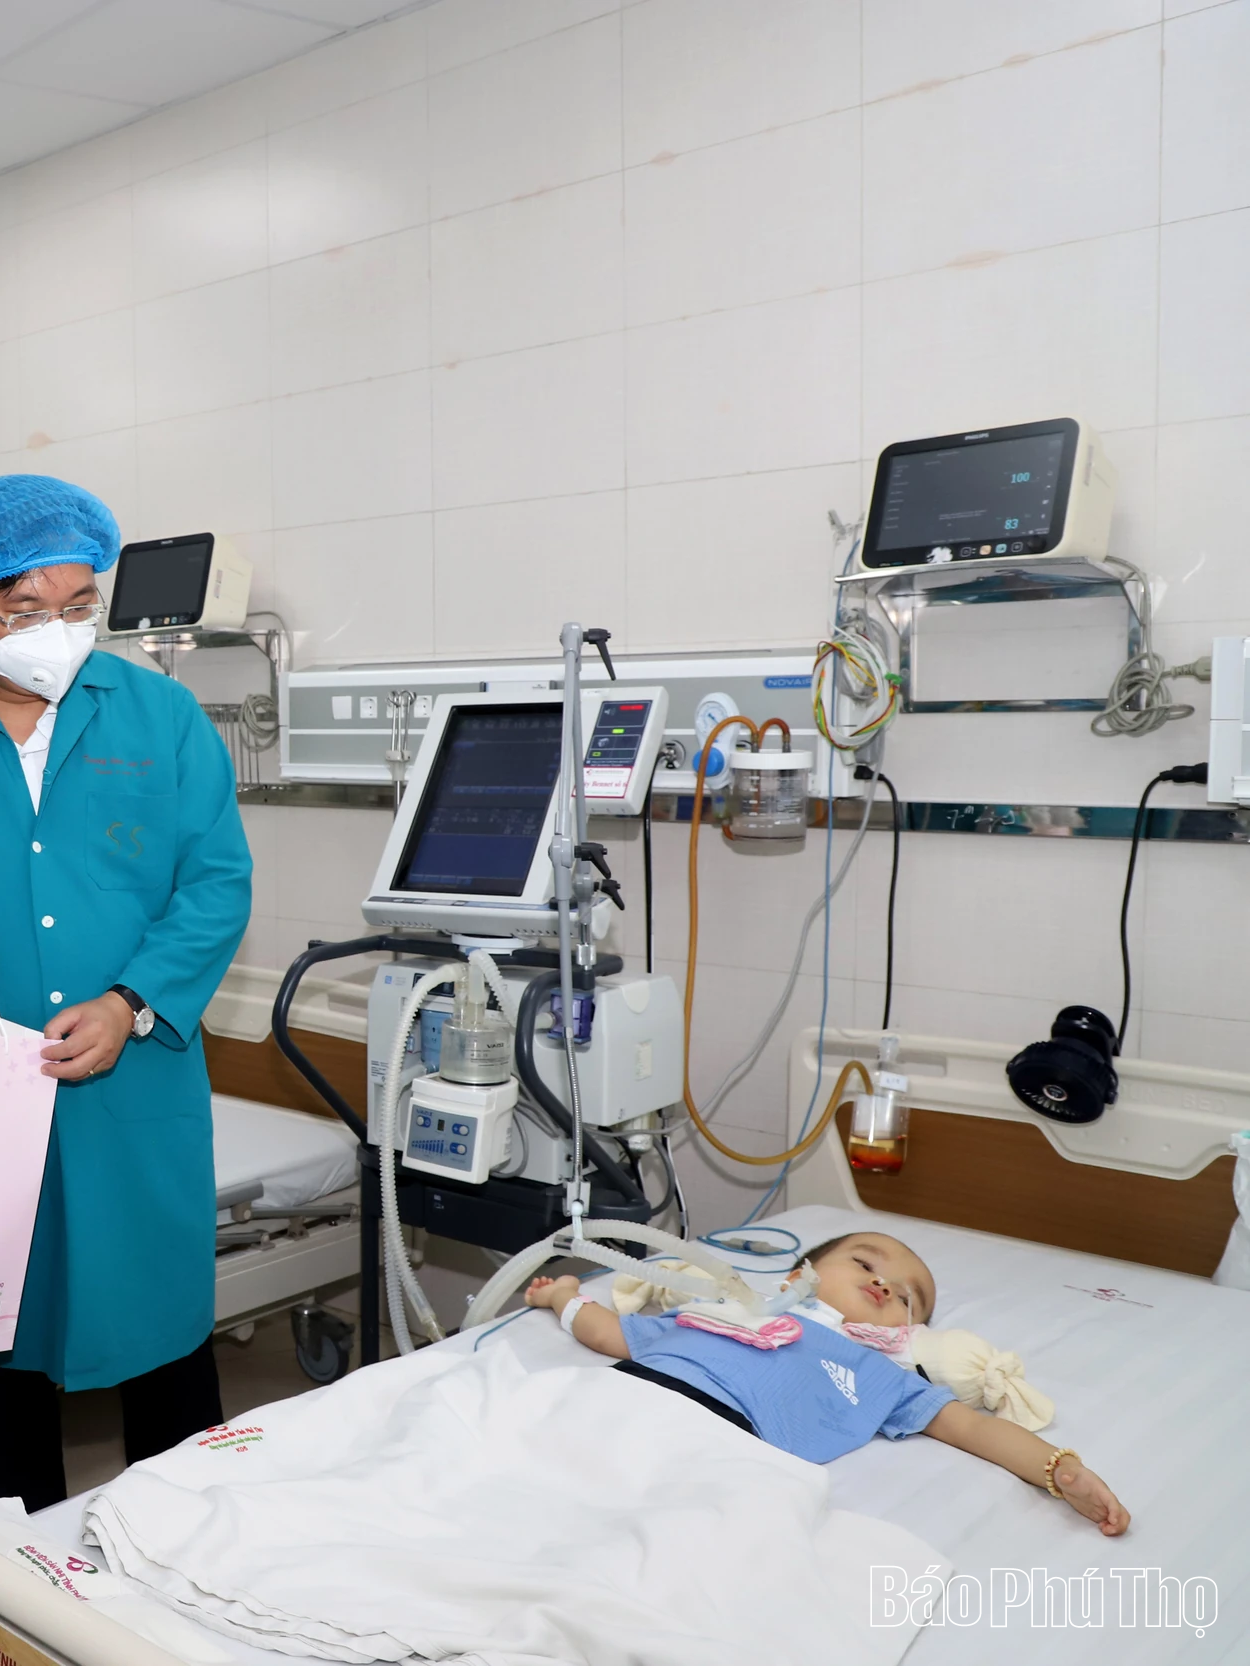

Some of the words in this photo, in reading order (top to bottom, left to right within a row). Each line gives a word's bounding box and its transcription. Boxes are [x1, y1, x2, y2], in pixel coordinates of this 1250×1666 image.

[1010, 472, 1030, 484] 100
[1004, 518, 1019, 530] 83
[820, 1359, 859, 1405] adidas
